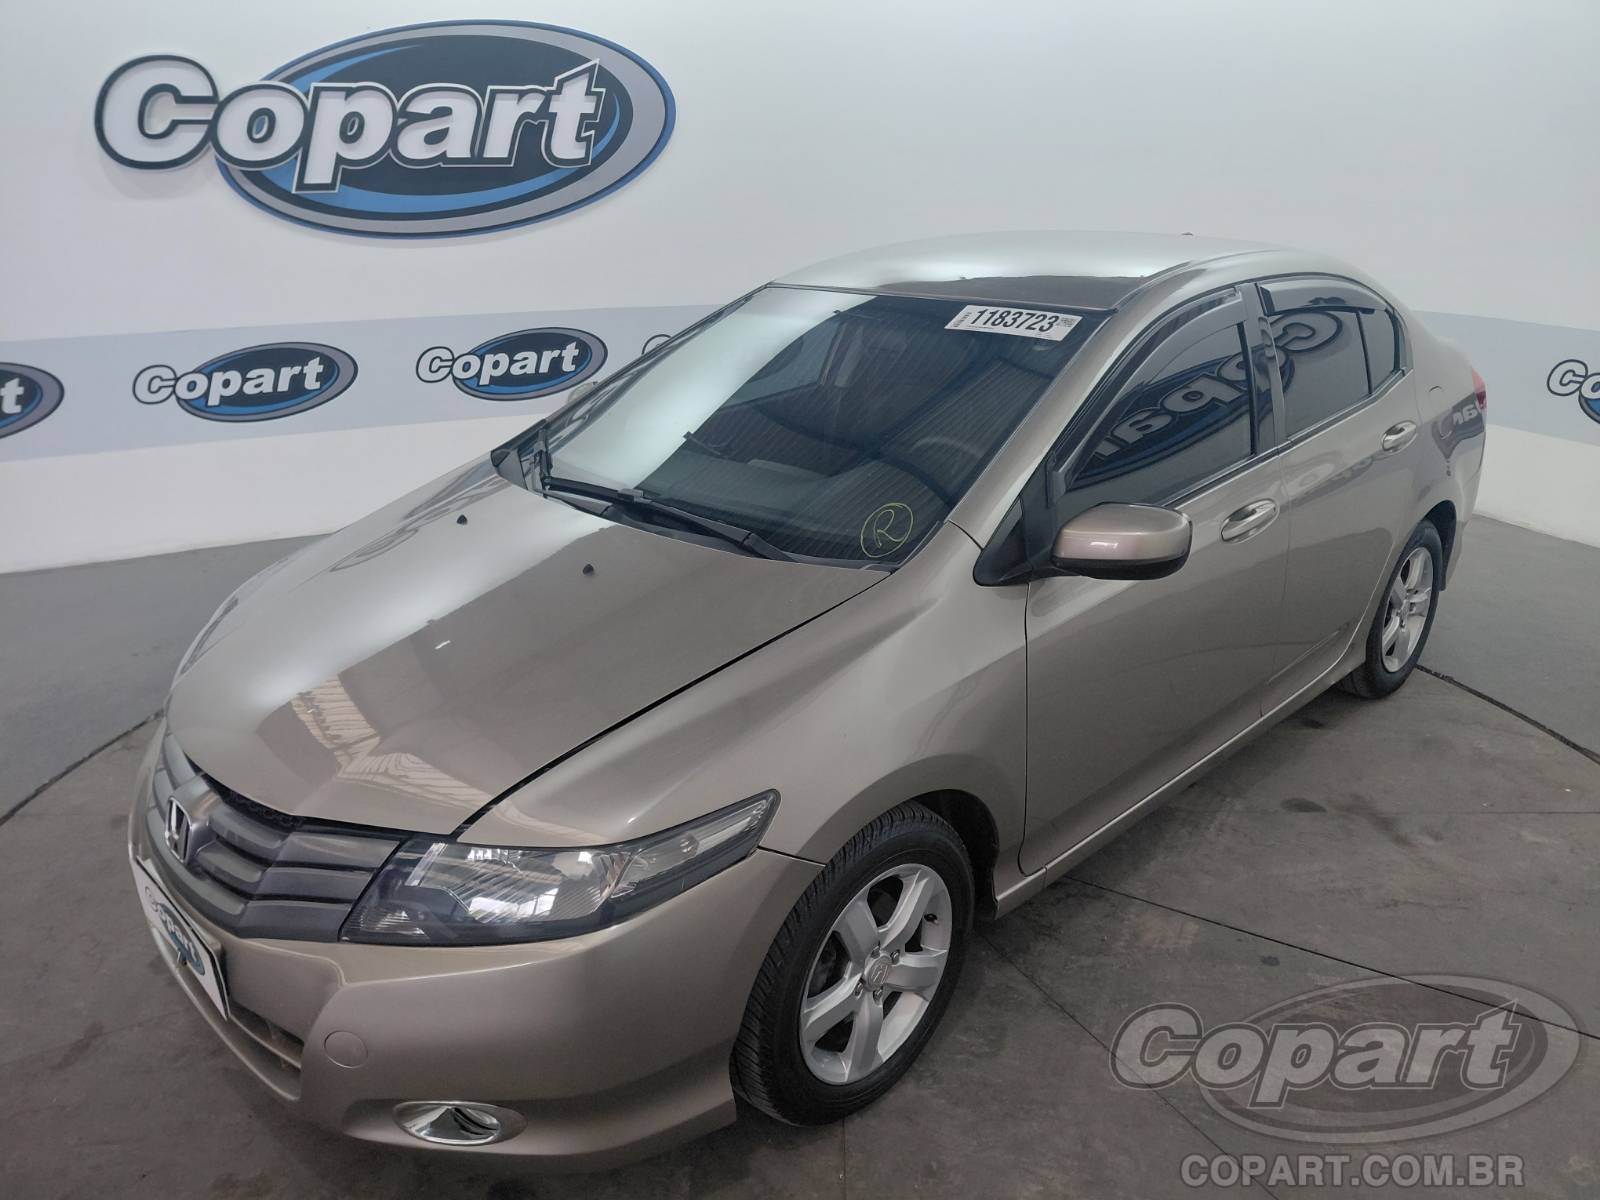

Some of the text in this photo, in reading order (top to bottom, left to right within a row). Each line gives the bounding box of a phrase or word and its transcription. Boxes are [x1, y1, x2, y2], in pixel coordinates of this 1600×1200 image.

[95, 54, 605, 193] Copart
[970, 308, 1060, 333] 1183723
[133, 357, 324, 407] Copart
[416, 346, 579, 386] Copart
[872, 508, 908, 549] R
